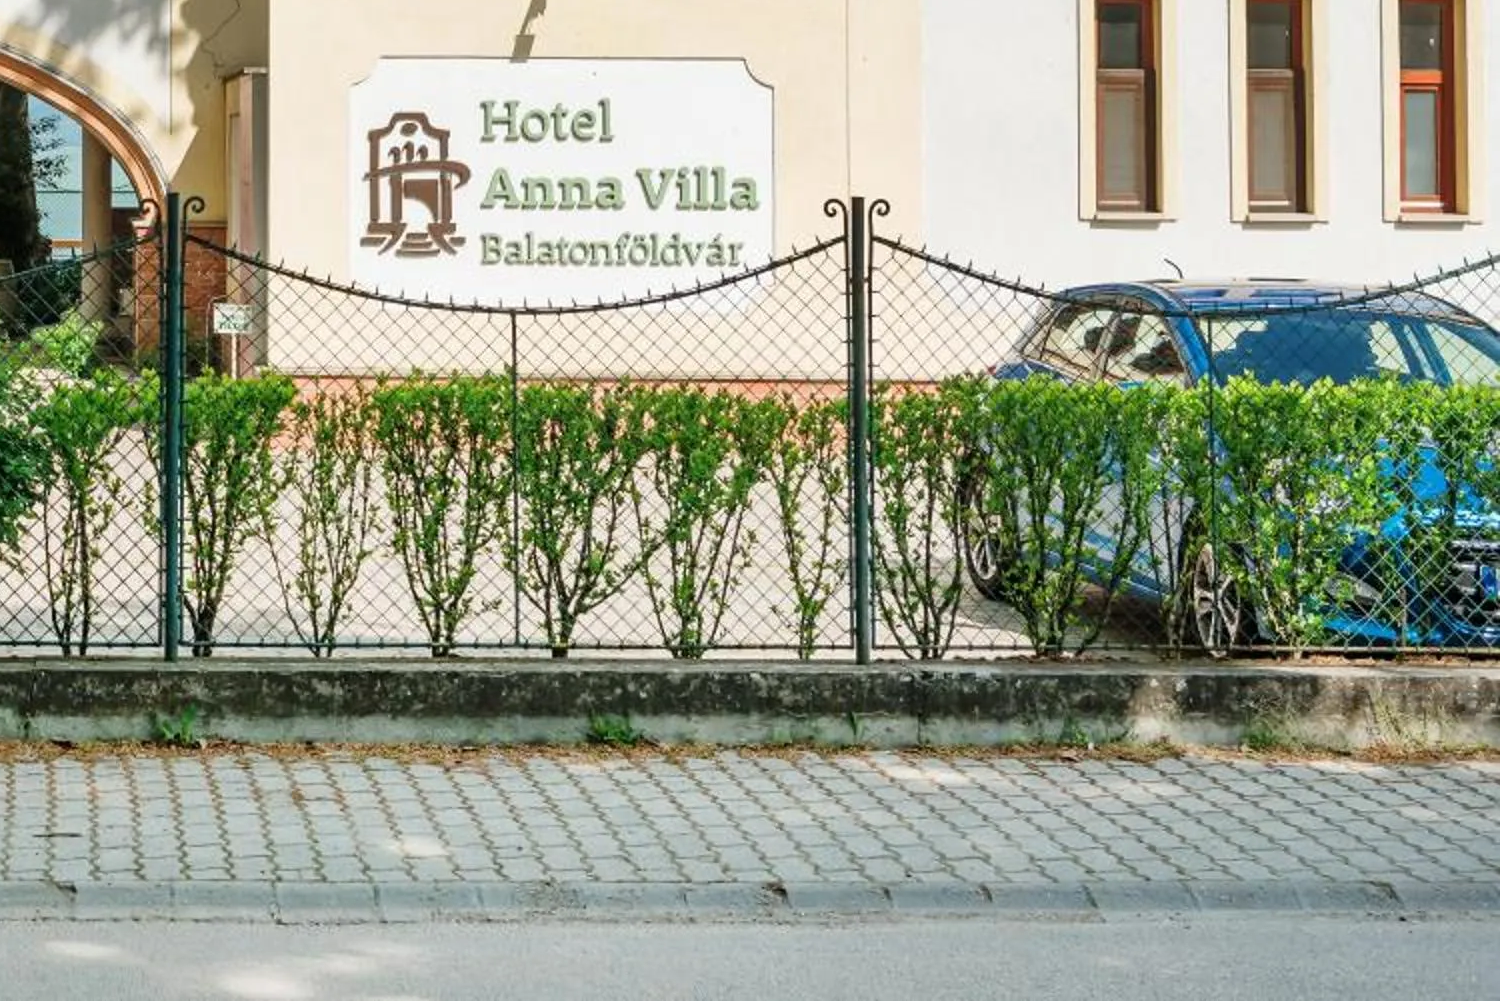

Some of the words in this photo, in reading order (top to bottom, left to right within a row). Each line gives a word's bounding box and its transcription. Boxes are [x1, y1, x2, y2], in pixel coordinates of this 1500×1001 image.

[479, 98, 614, 143] Hotel
[479, 166, 626, 211] Anna
[635, 165, 760, 211] Villa
[479, 232, 744, 267] Balatonföldvár
